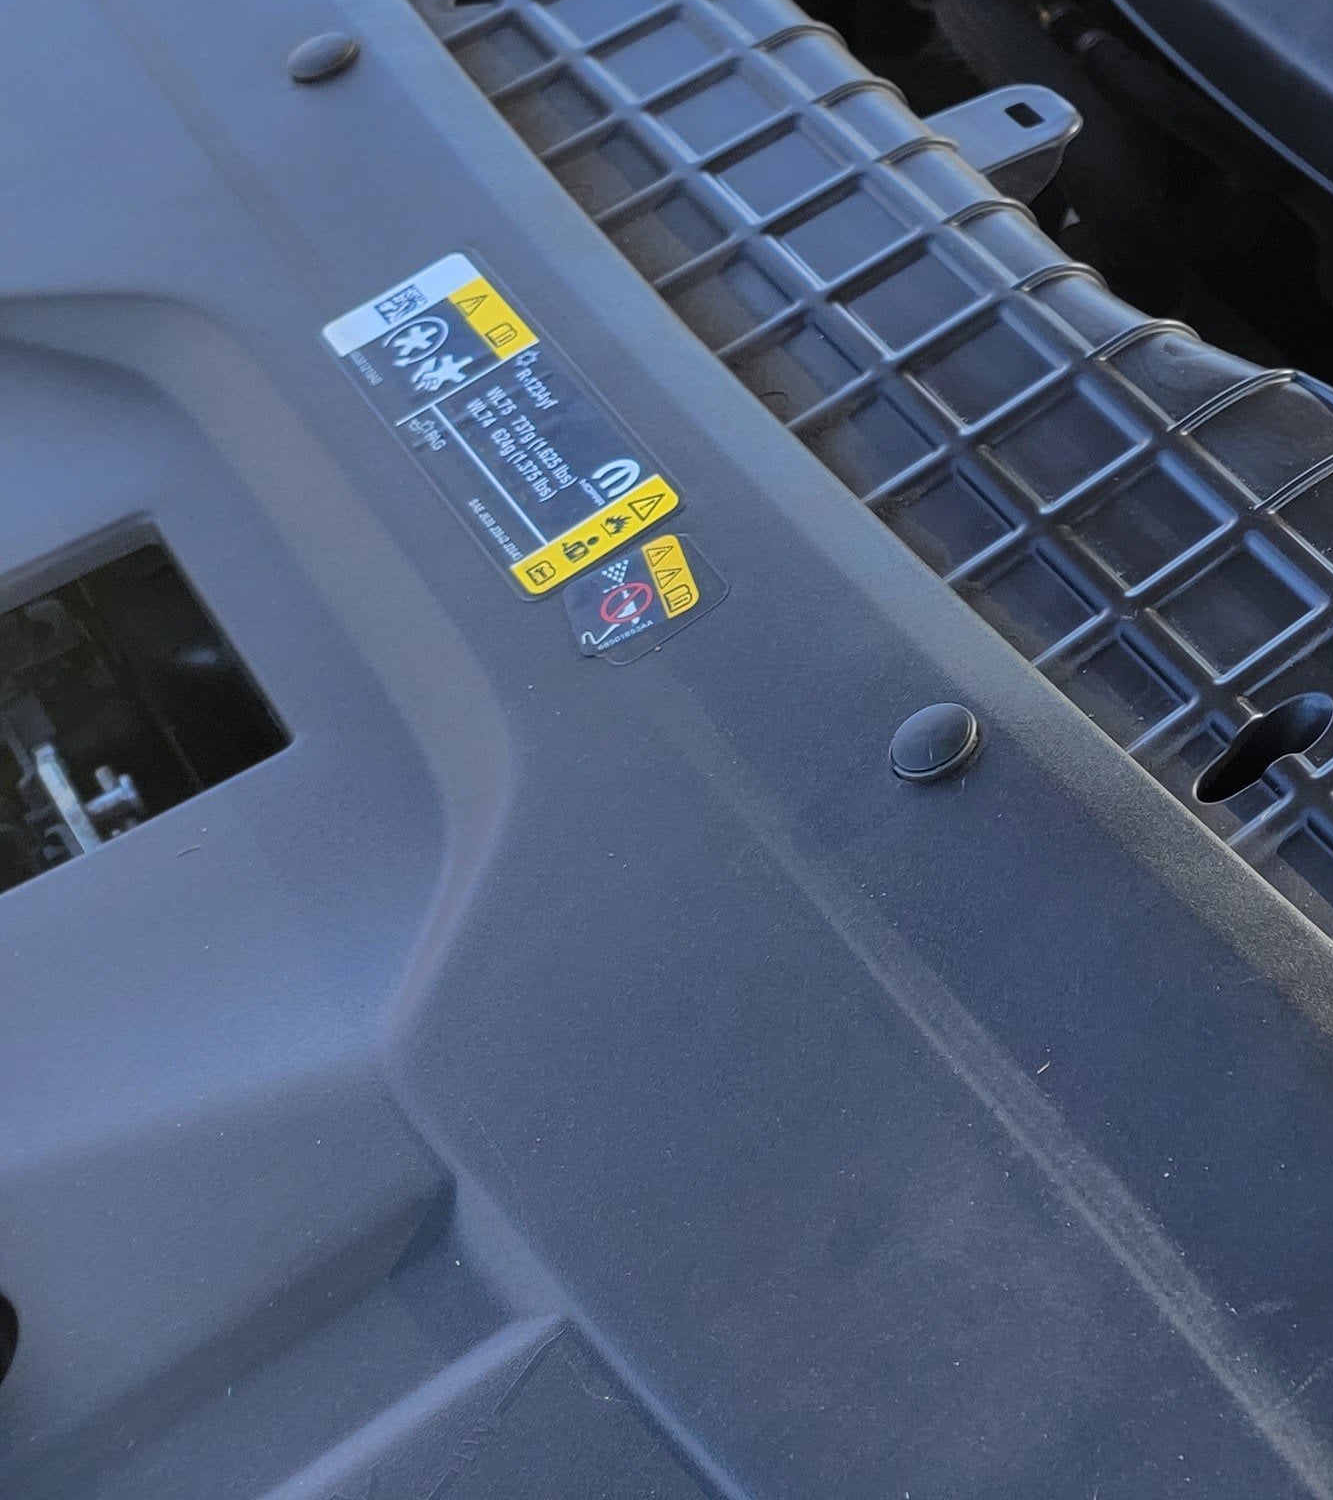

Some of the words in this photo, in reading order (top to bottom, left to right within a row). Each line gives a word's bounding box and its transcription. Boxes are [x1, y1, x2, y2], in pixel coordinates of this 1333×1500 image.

[424, 429, 447, 451] PAG
[465, 398, 497, 428] WL74
[490, 428, 517, 457] 624g
[507, 450, 543, 482] (1.375
[532, 477, 558, 503] lbs)
[486, 386, 518, 416] WL75
[510, 415, 537, 445] 737g
[527, 437, 563, 470] (1.625
[552, 464, 579, 490] lbs)
